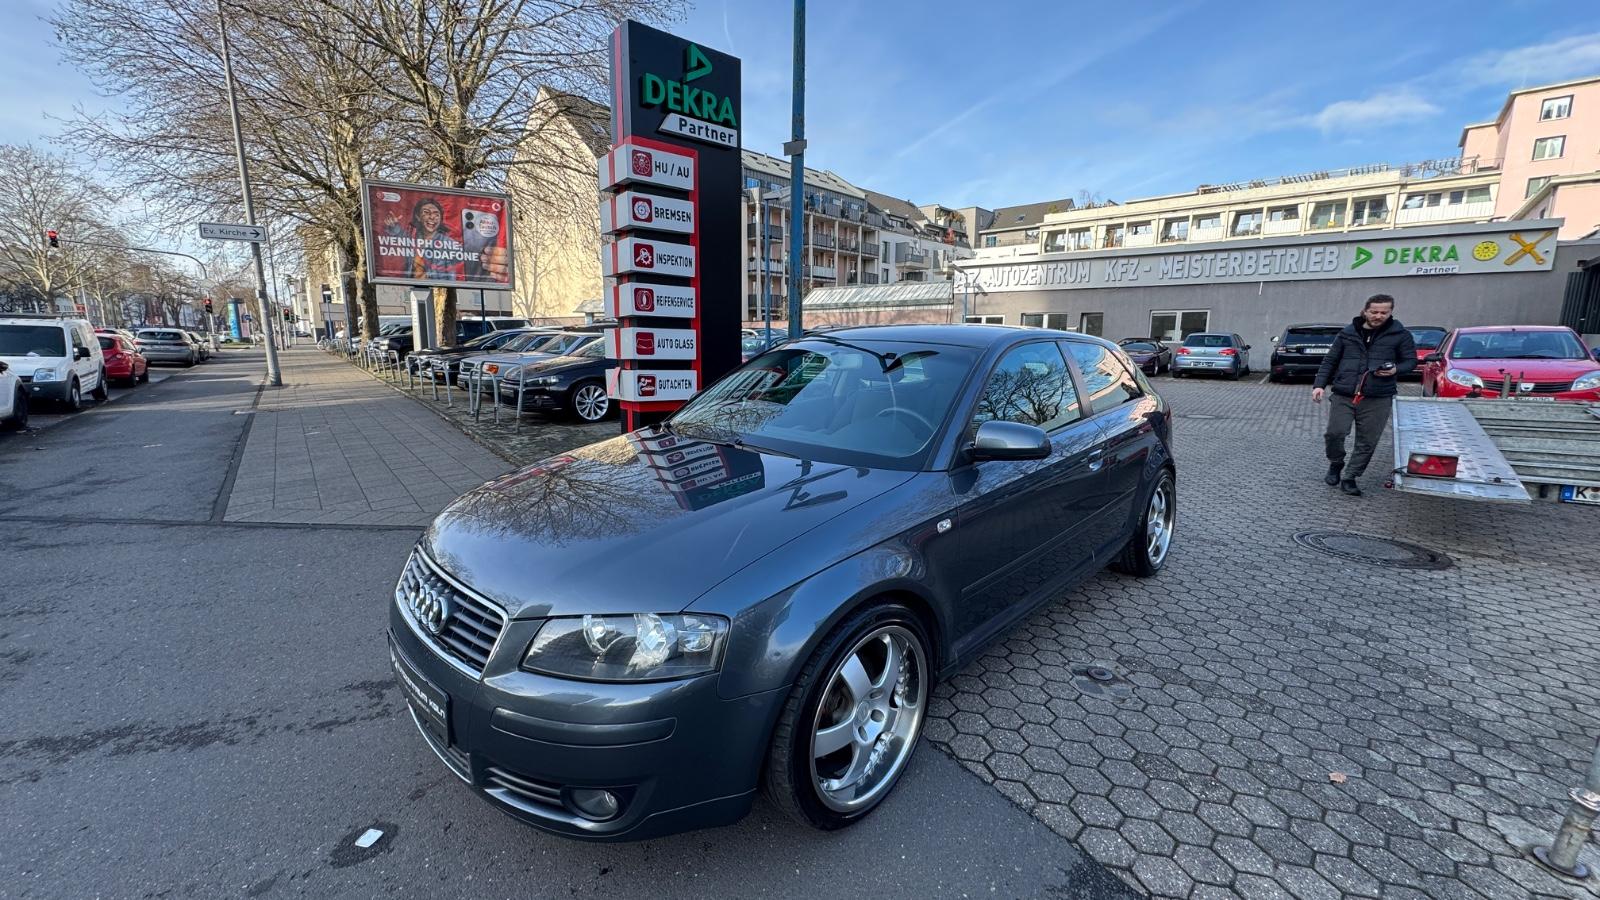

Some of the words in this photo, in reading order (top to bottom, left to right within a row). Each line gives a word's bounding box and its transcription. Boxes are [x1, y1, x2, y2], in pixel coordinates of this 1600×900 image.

[644, 72, 737, 126] DEKRA
[678, 117, 734, 144] Partner
[654, 160, 668, 173] HU
[676, 166, 690, 179] AU
[654, 206, 692, 223] BREMSEN
[203, 227, 216, 235] Ev.
[220, 228, 247, 237] Kirche
[378, 235, 416, 248] WENN
[379, 246, 415, 258] DANN
[416, 248, 480, 262] VODAFONE
[656, 252, 693, 268] INSPEKTION
[1383, 244, 1460, 265] DEKRA
[984, 260, 1091, 288] AUTOZENTRUM
[1159, 245, 1340, 281] MEISTERBETRIEB
[1416, 266, 1457, 274] Partner
[656, 293, 694, 309] REIFENSERVICE
[657, 338, 674, 349] AUTO
[674, 338, 694, 350] GLASS
[658, 378, 693, 390] GUTACHTEN
[1576, 486, 1588, 499] K
